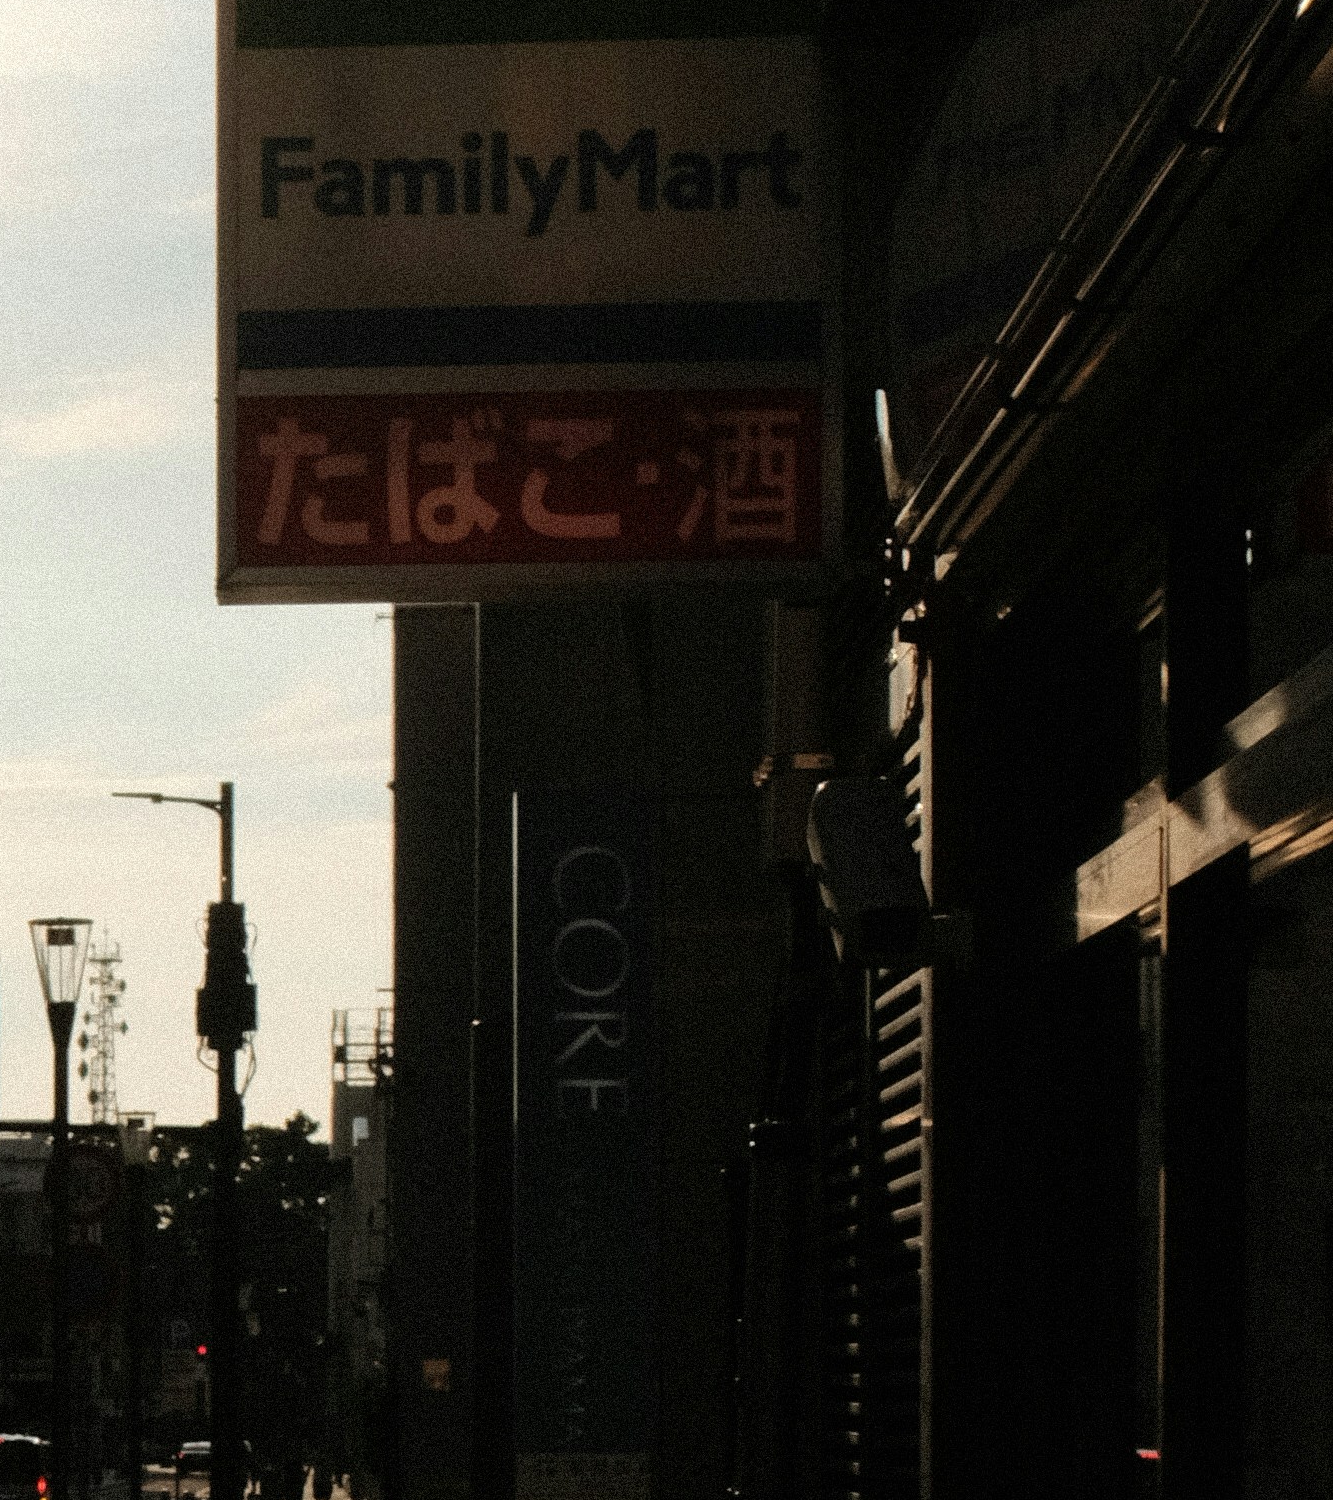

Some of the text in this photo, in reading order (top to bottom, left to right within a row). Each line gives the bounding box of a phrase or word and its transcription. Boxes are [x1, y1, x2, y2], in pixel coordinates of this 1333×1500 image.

[259, 128, 801, 237] FamilyMart
[258, 407, 799, 546] たばこ・酒
[551, 843, 631, 1118] CORE
